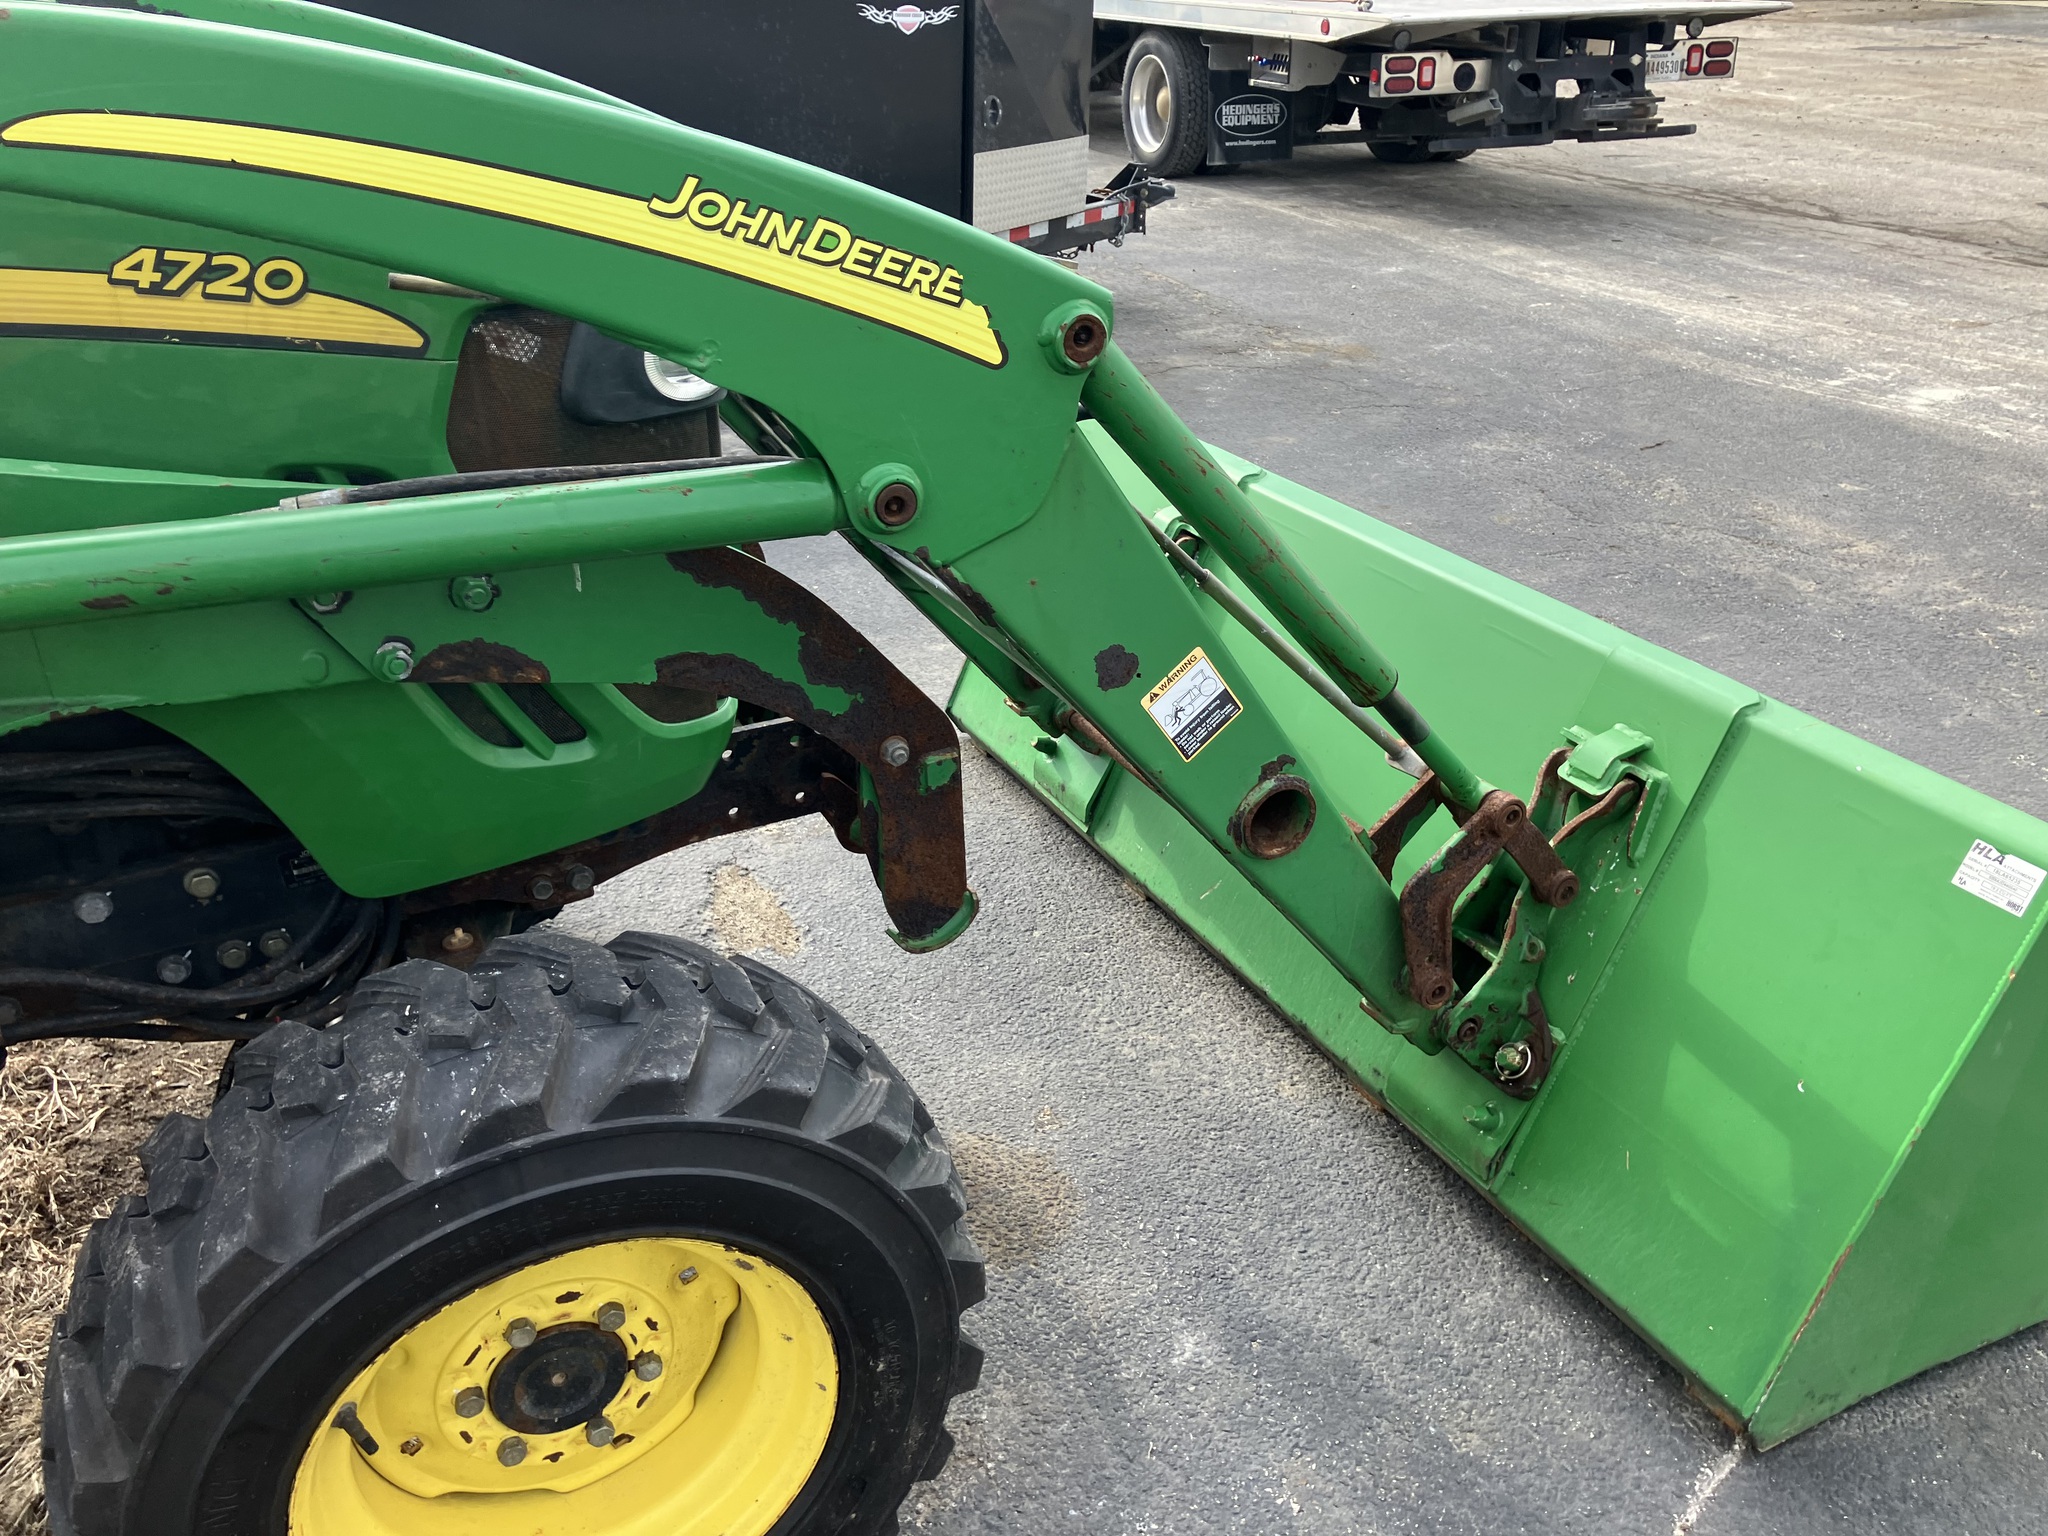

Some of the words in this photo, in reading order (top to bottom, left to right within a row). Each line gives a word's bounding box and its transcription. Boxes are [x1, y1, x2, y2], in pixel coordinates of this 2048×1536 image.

[1222, 114, 1280, 127] EQUIPMENT
[1225, 139, 1276, 147] www.hedingers.com
[647, 173, 803, 256] JOHN
[797, 215, 965, 308] DEERE
[108, 246, 308, 303] 4720
[1157, 654, 1198, 691] WARNING
[1971, 842, 2006, 865] HLA
